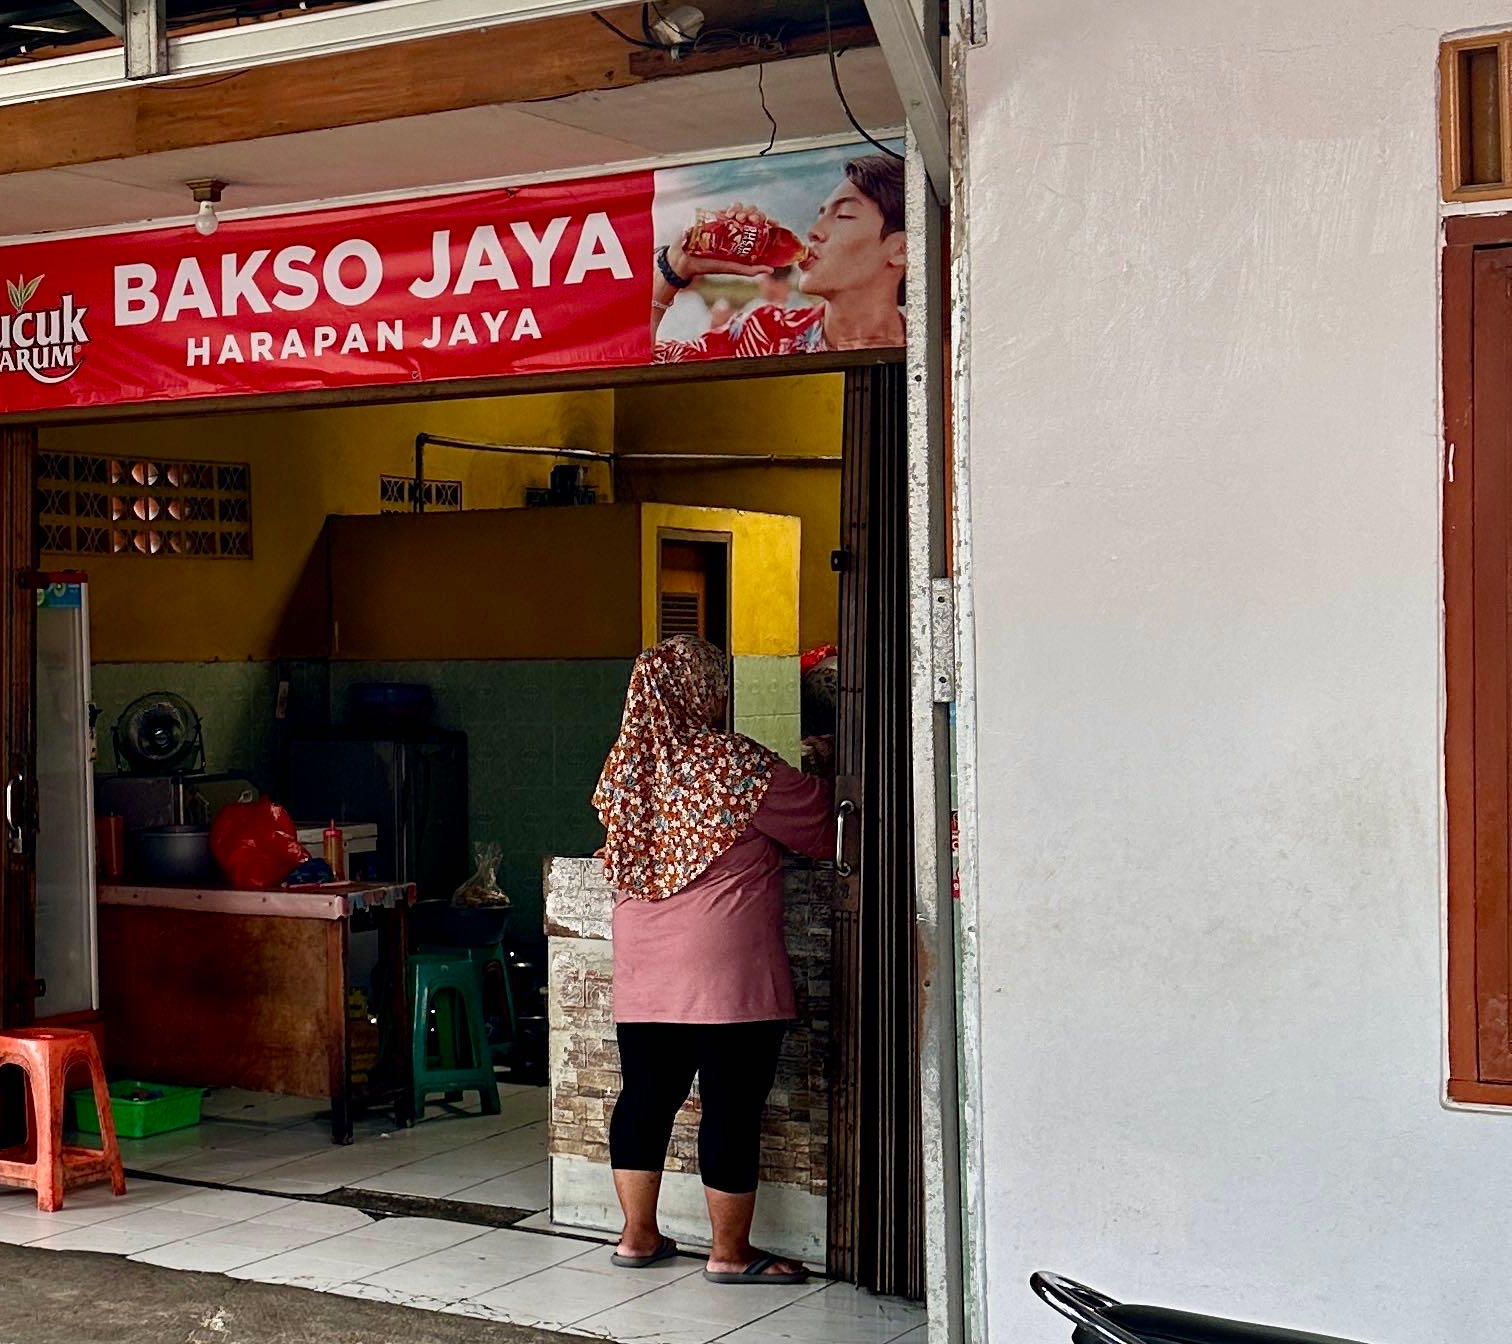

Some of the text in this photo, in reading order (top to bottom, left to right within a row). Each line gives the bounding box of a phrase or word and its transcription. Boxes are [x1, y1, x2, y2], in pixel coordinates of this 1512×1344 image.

[114, 211, 634, 327] BAKSO JAYA
[185, 307, 543, 367] HARAPAN JAYA
